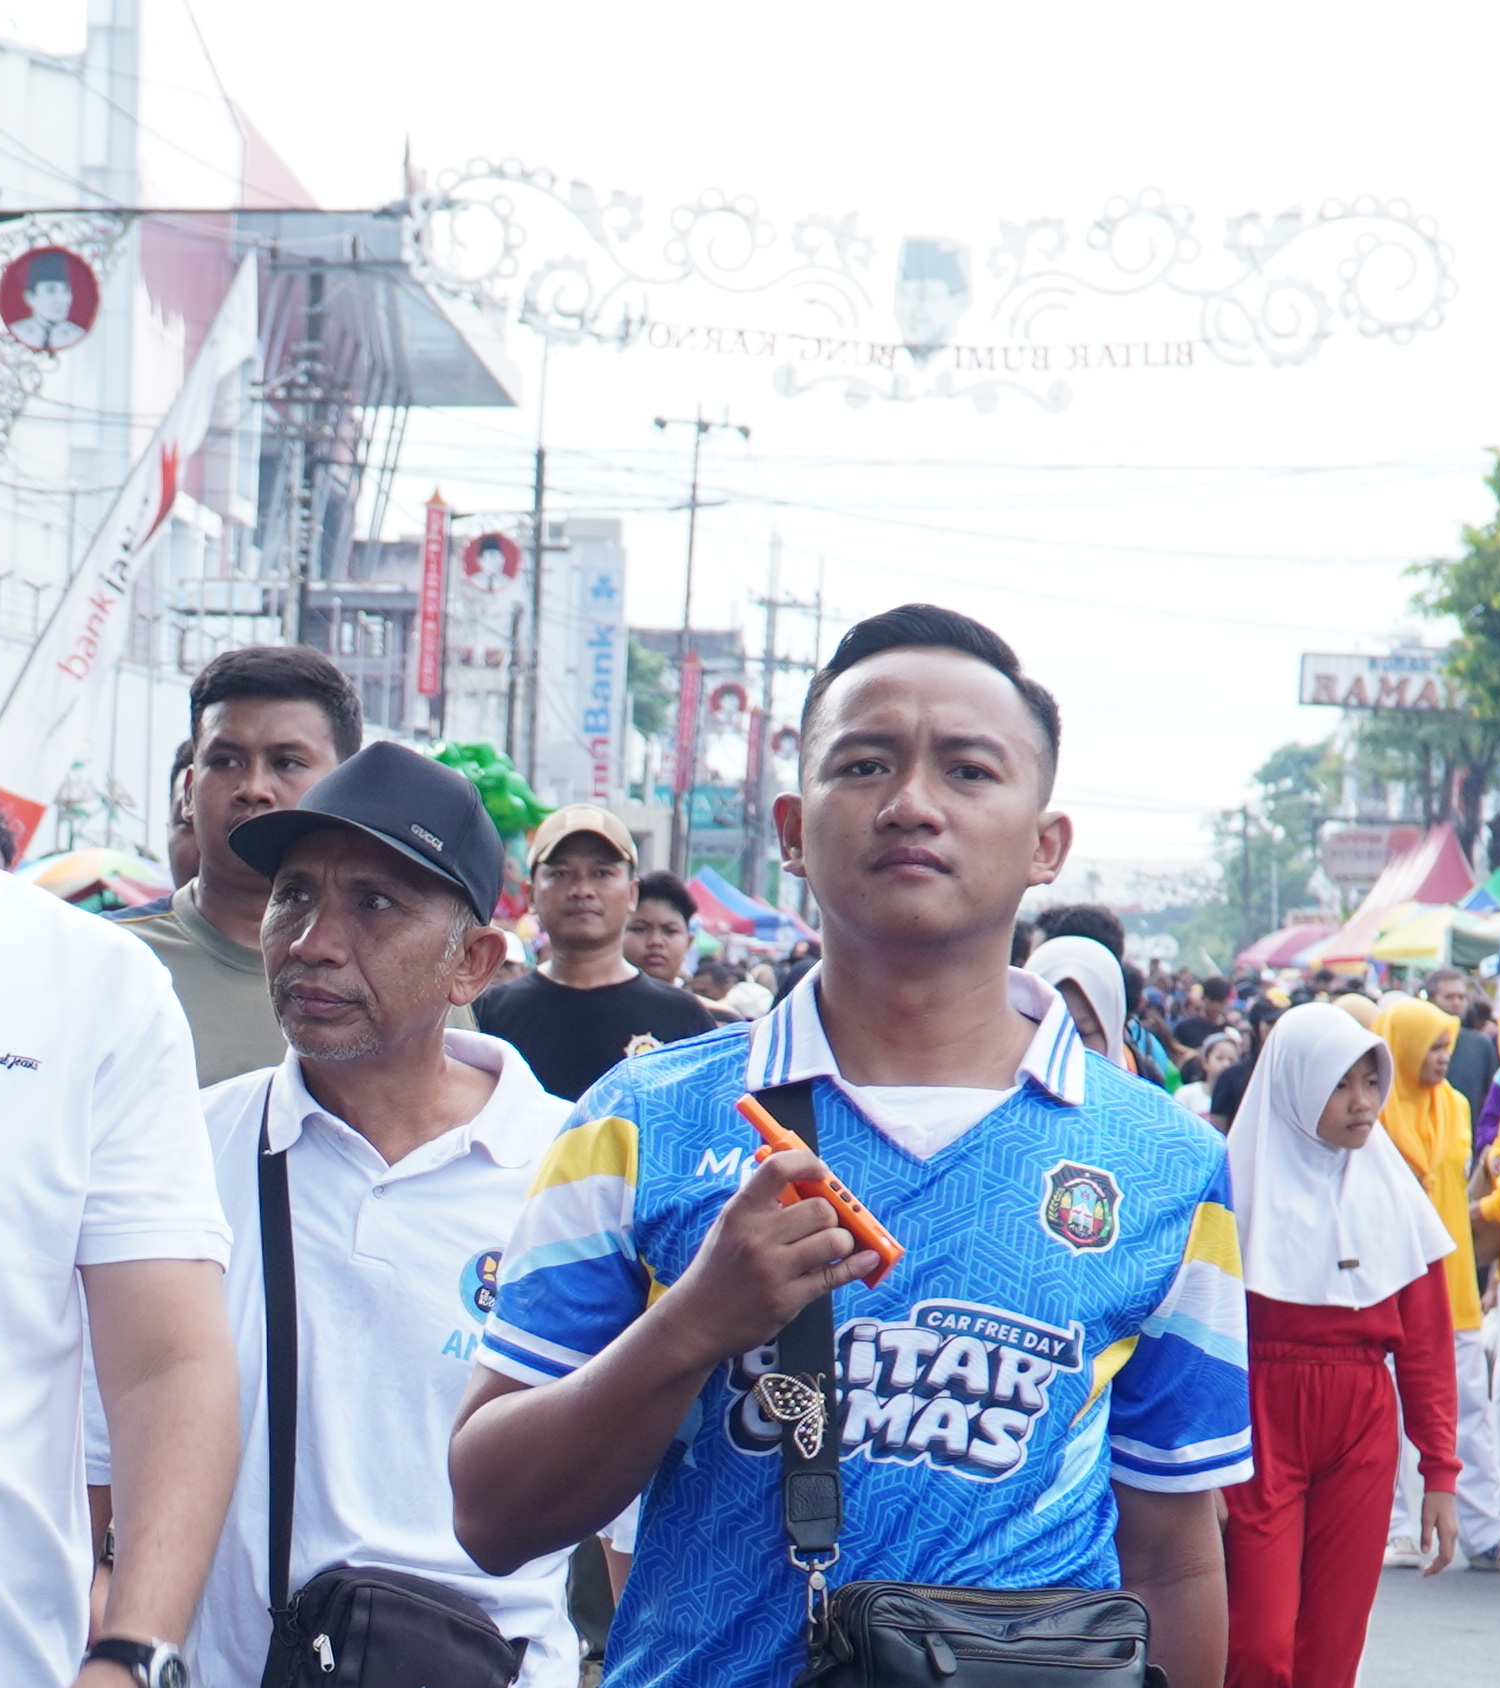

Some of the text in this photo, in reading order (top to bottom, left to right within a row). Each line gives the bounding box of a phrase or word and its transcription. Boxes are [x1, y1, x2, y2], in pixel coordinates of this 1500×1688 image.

[926, 1311, 1067, 1357] CAR FREE DAY
